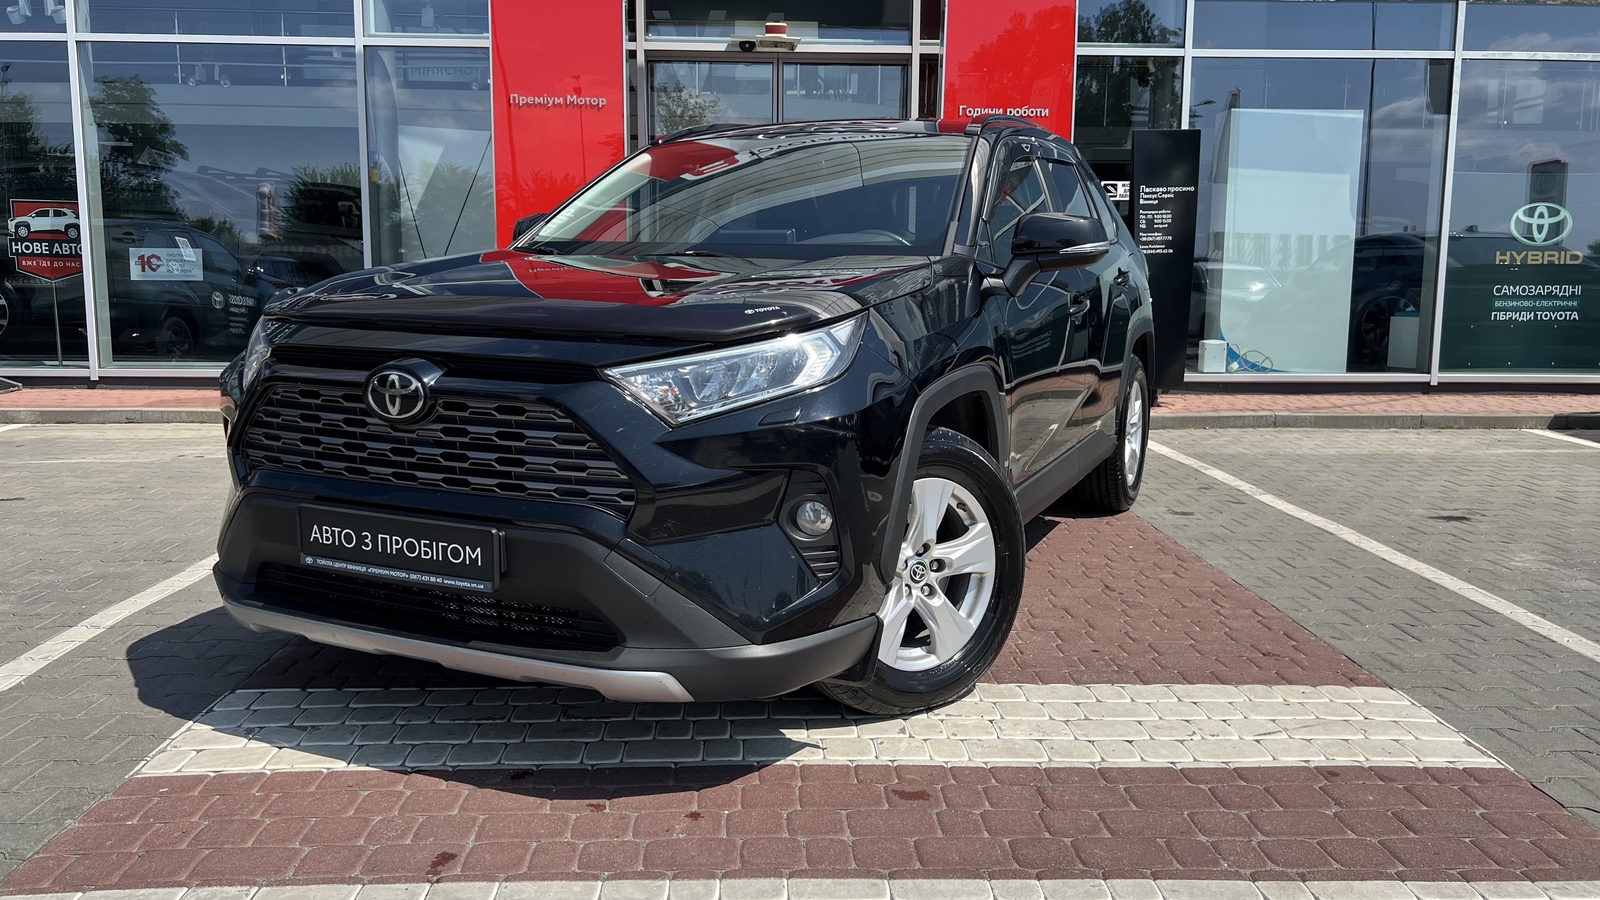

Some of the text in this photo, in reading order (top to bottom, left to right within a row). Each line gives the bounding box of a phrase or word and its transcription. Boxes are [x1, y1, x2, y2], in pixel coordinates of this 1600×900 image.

[510, 94, 607, 107] Преміум Мотор
[959, 105, 1049, 118] Години роботи
[1140, 185, 1167, 193] Ласкаво
[12, 242, 50, 254] НОВЕ
[1495, 251, 1584, 265] HYBRID
[1493, 285, 1581, 297] САМОЗАРЯДНІ
[754, 305, 781, 313] TOYOTA
[1491, 312, 1579, 321] ГІБРИДИ TOYOTA
[310, 524, 482, 567] АВТО З ПРОБІГОМ
[409, 573, 422, 581] (067)
